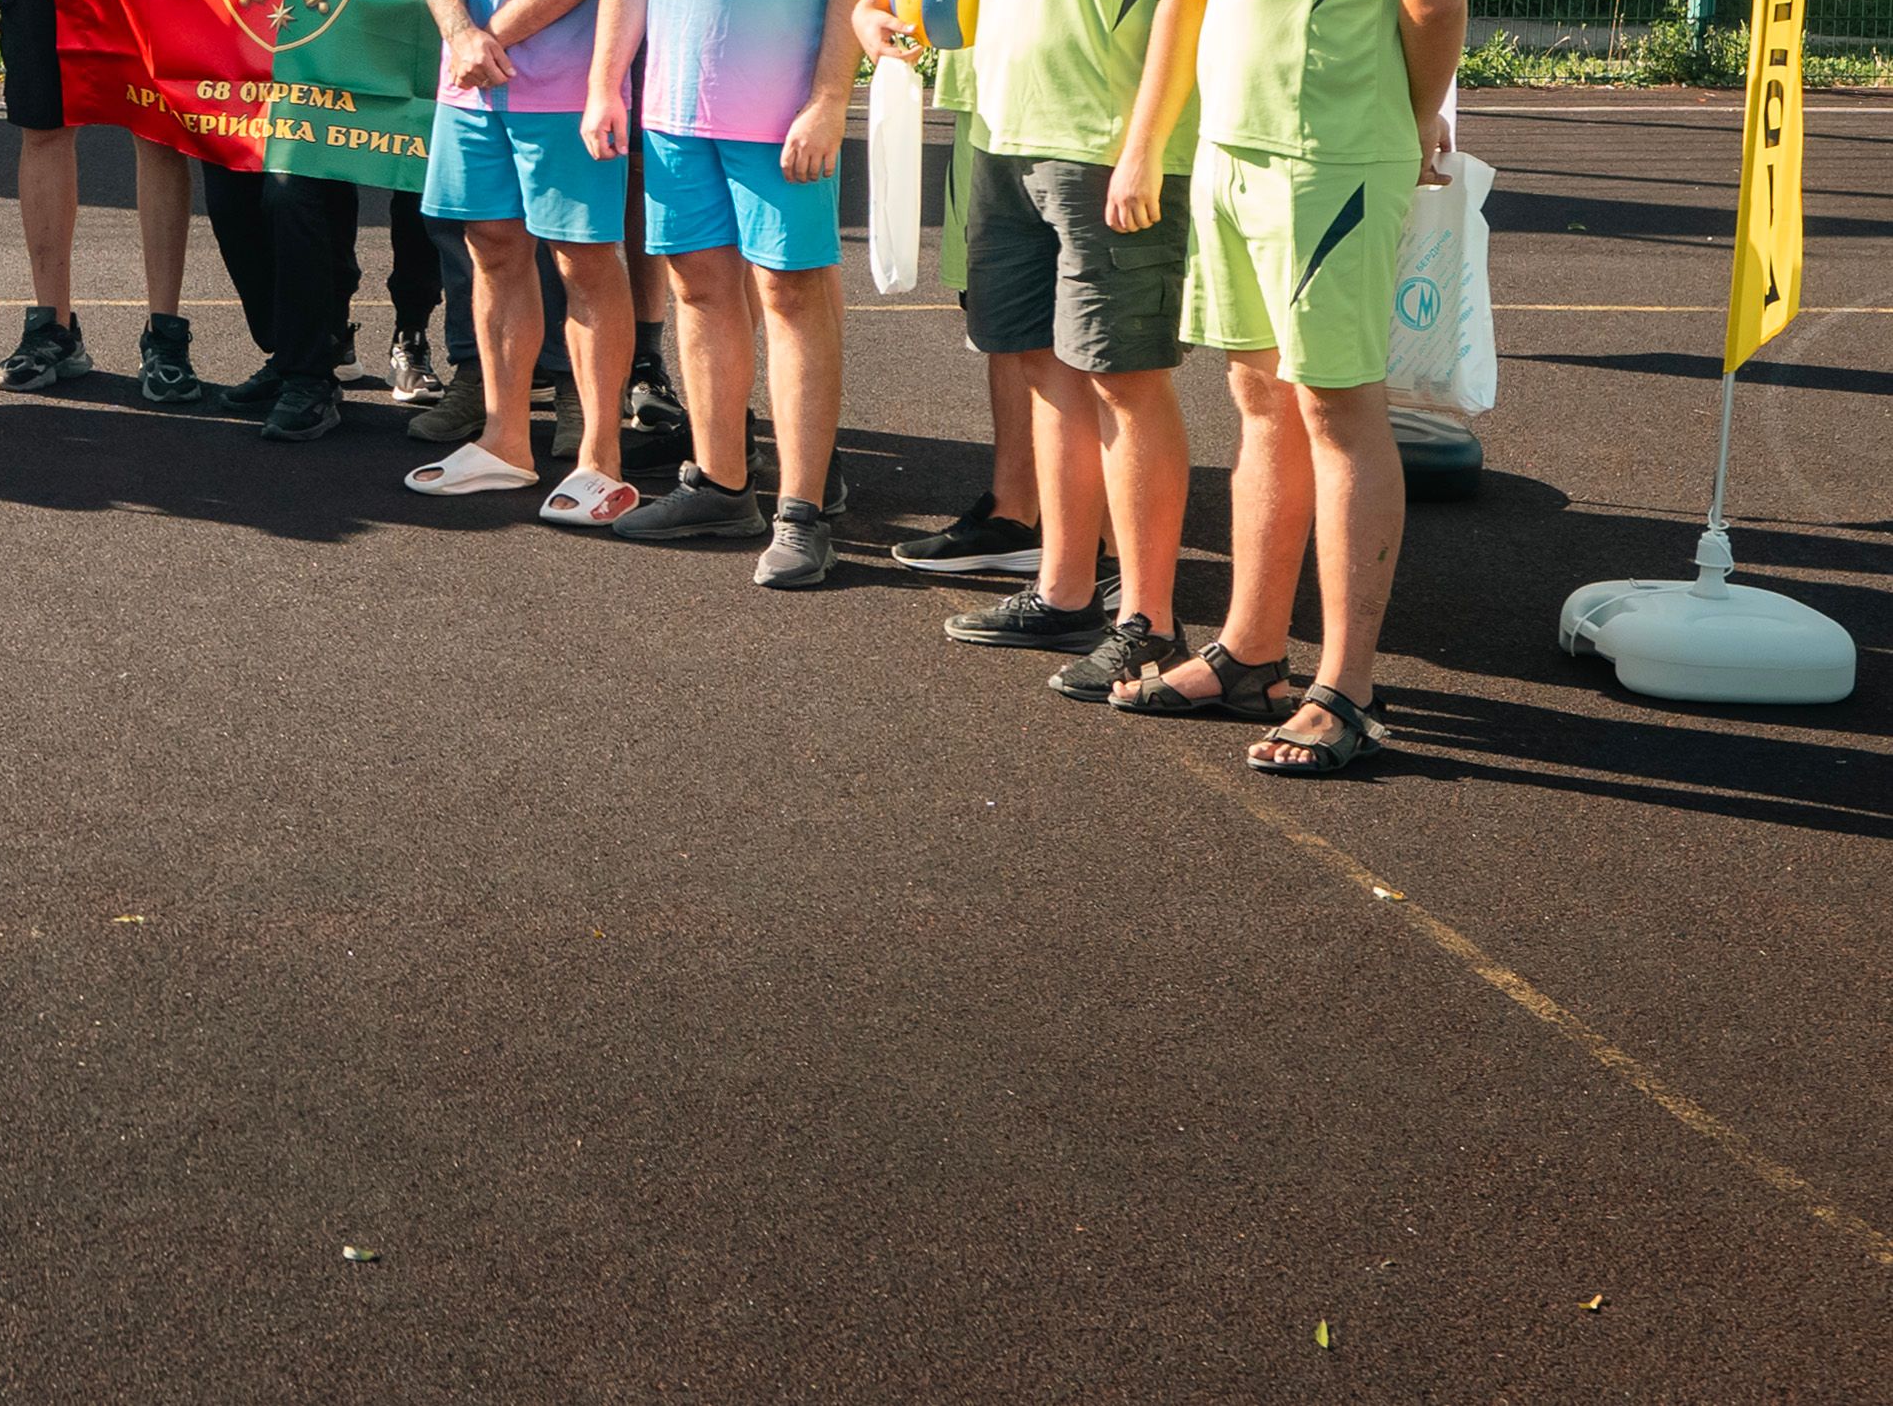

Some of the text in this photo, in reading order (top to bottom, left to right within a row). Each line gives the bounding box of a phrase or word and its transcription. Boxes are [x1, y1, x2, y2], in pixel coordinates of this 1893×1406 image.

[125, 84, 316, 142] АРТЕРІЙСЬКА
[196, 79, 357, 112] 68 ОКРЕМА
